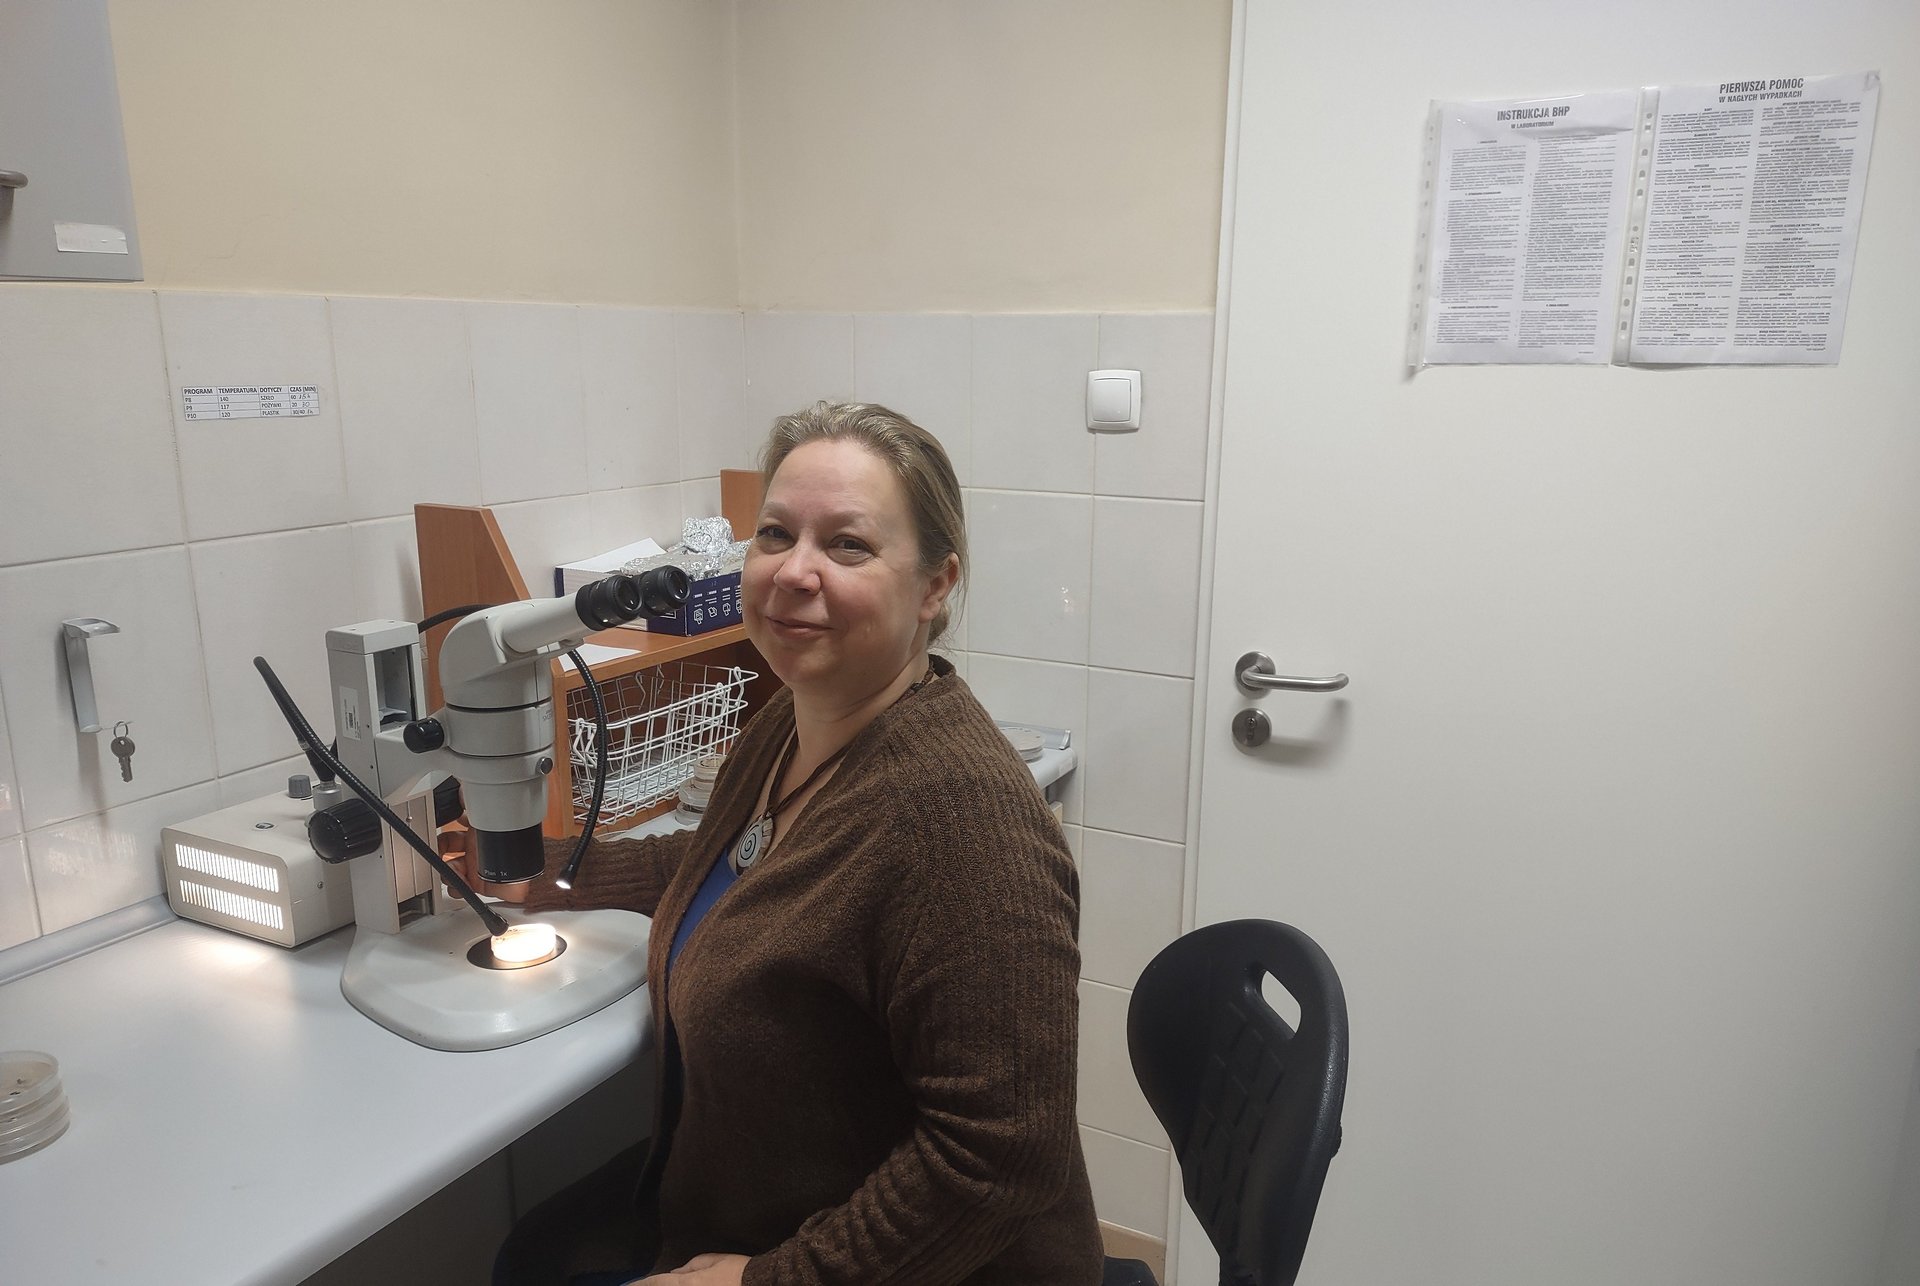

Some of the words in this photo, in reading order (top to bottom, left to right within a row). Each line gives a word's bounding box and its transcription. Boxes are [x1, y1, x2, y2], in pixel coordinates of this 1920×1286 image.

[1719, 80, 1766, 94] PIERWSZA
[1769, 77, 1804, 90] POMOC
[1727, 93, 1758, 103] NAGŁYCH
[1759, 90, 1803, 101] WYPADKACH
[1497, 107, 1550, 121] INSTRUKCJA
[1552, 105, 1571, 117] BHP
[1516, 121, 1555, 129] LABORATORIUM
